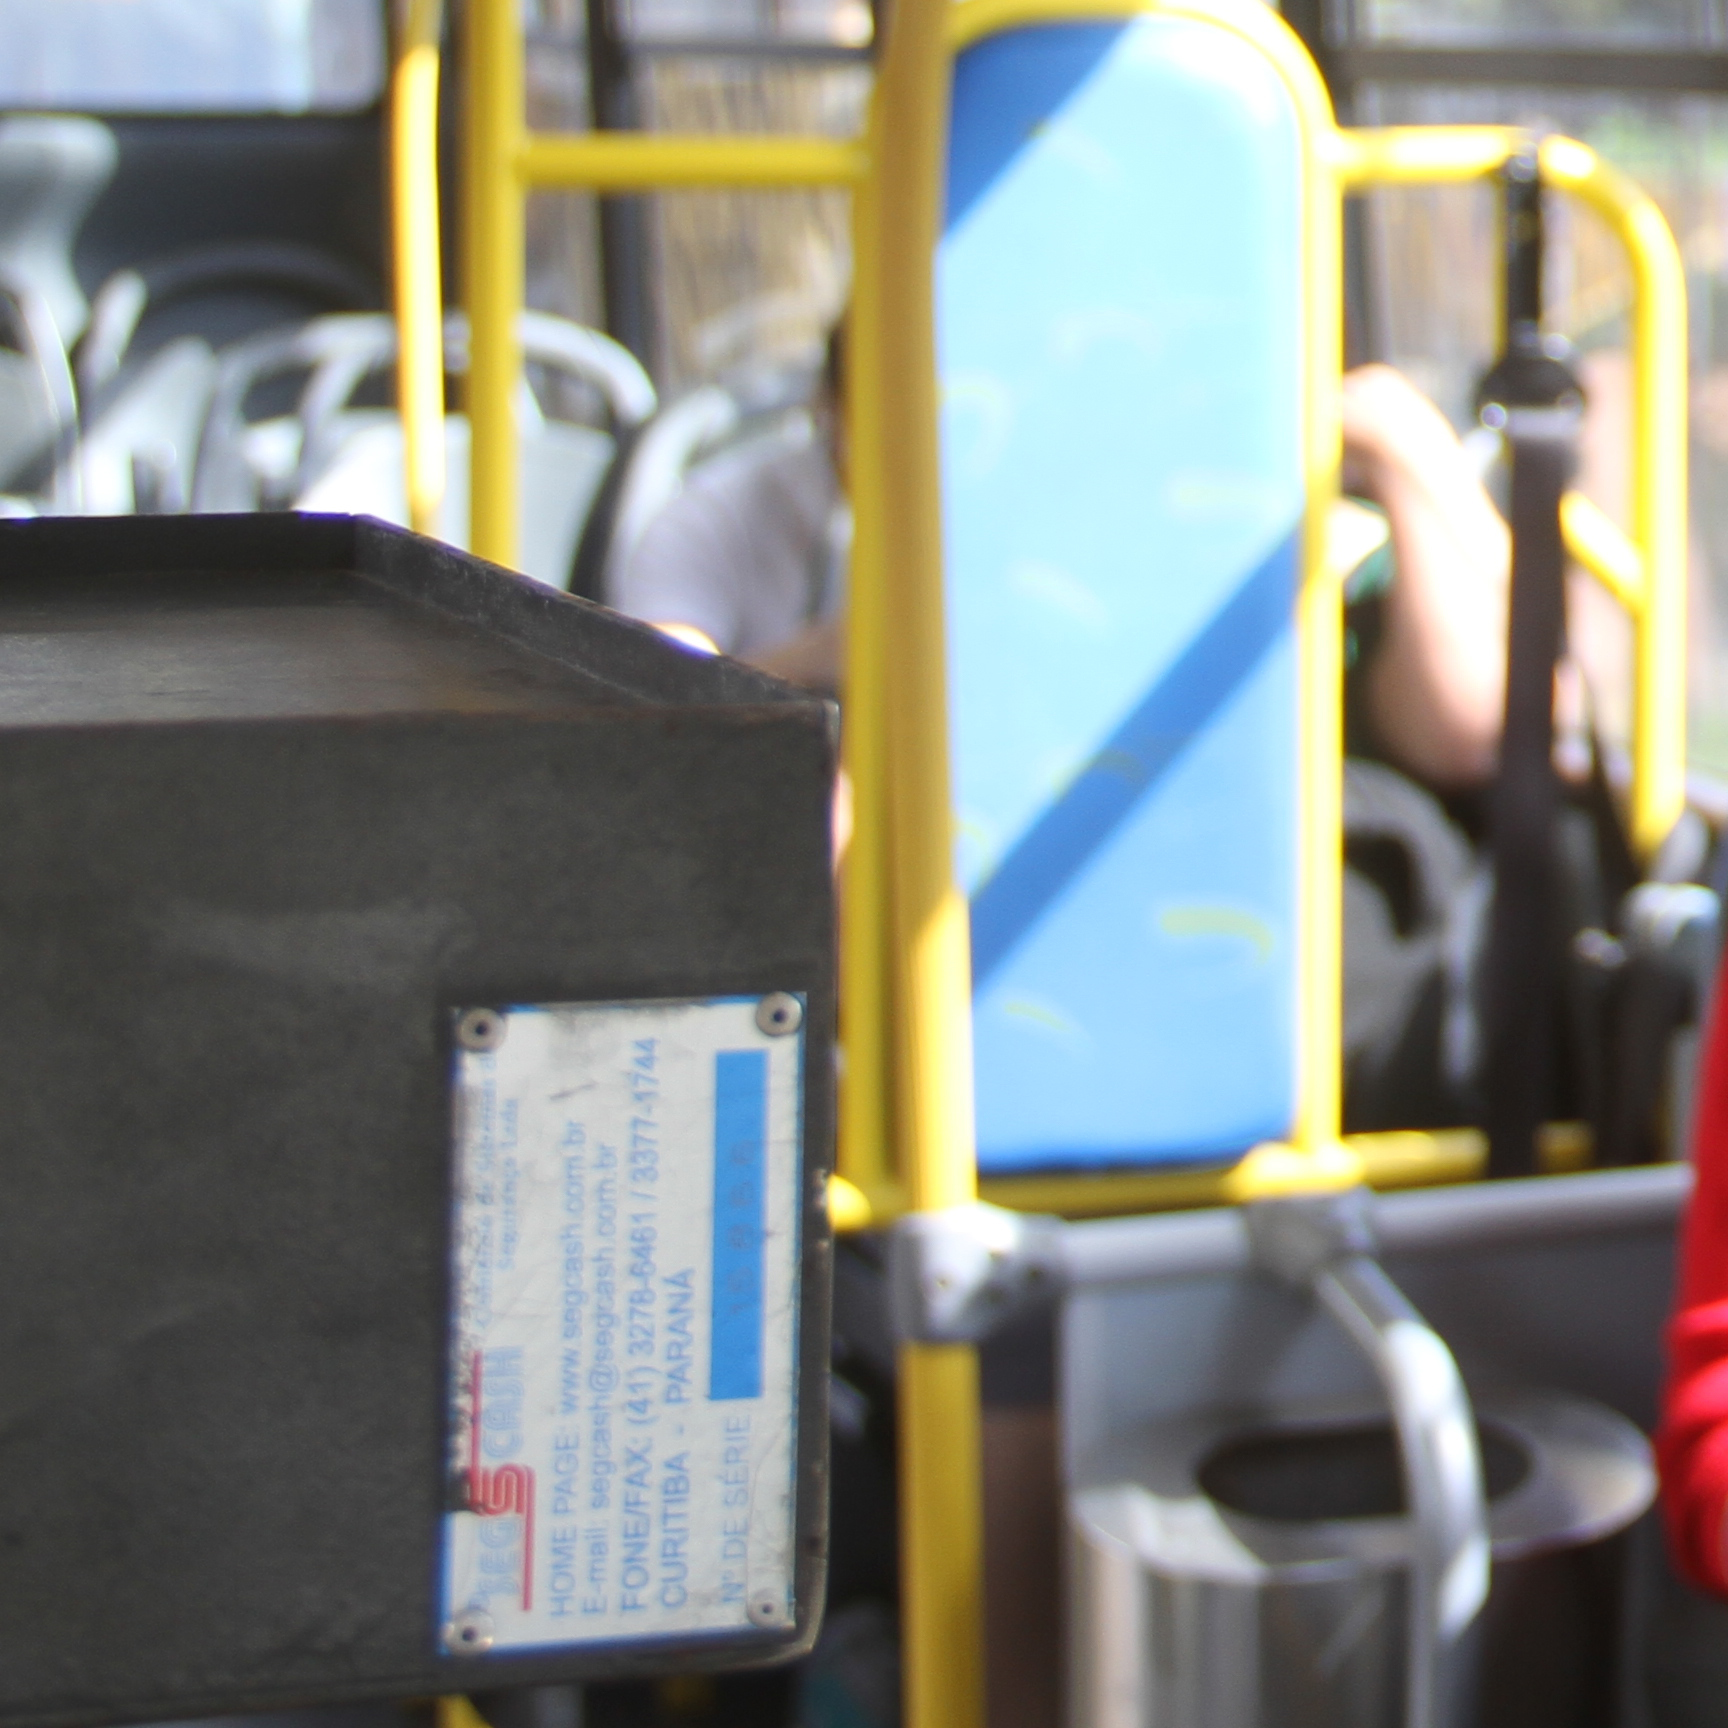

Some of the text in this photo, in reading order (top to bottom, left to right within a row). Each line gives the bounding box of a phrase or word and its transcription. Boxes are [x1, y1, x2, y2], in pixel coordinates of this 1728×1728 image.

[630, 1037, 660, 1183] 3377-1744
[559, 1121, 588, 1415] www.segcash.com.br
[589, 1143, 622, 1511] segcash@segcash.com.br
[661, 1266, 696, 1404] PARANÁ
[481, 1344, 526, 1460] CASH
[627, 1366, 661, 1426] (41)
[719, 1414, 750, 1507] SÉRIE
[549, 1524, 577, 1616] HOME
[621, 1438, 652, 1613] FONE/FAX:
[659, 1451, 690, 1609] CURITIBA
[722, 1516, 749, 1560] DE
